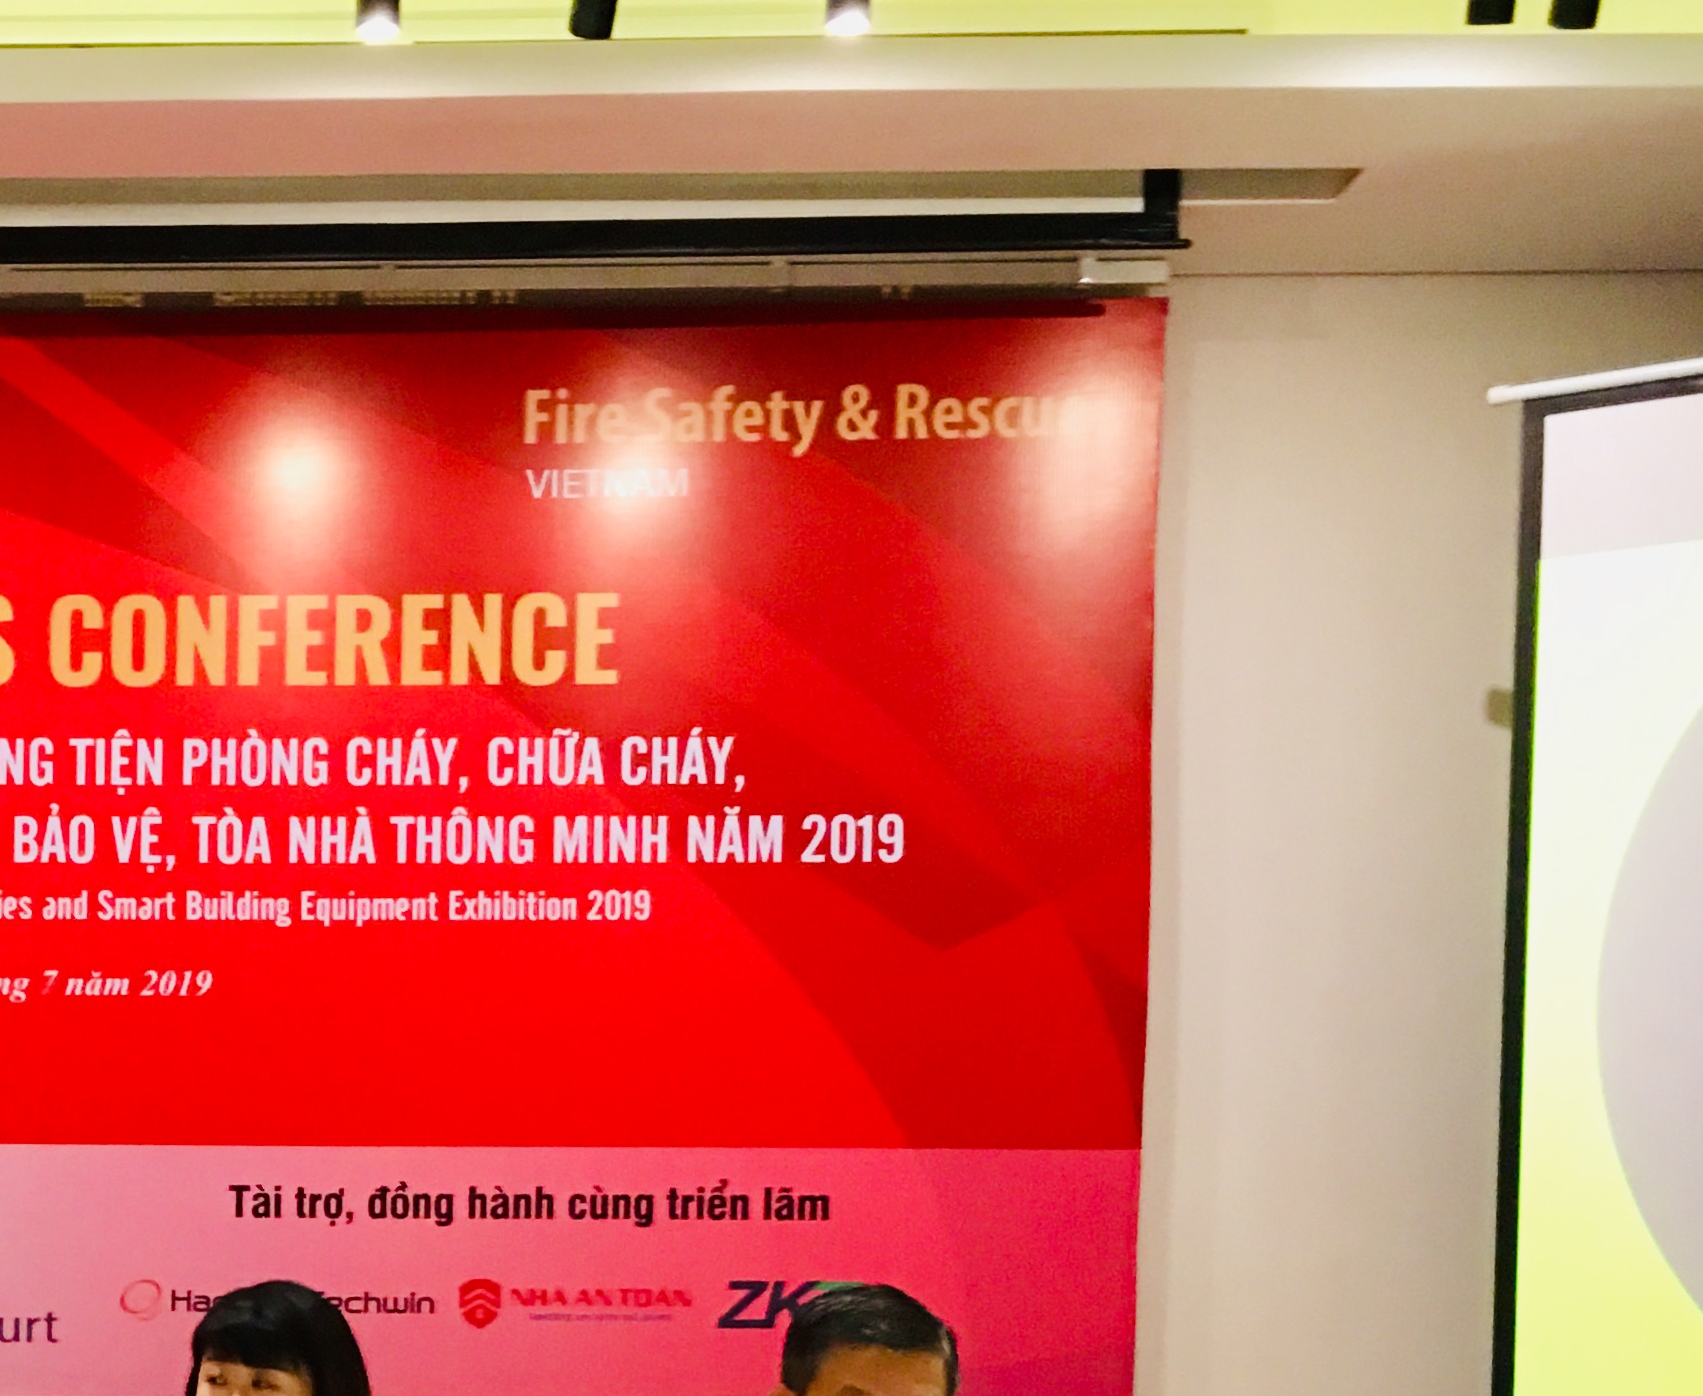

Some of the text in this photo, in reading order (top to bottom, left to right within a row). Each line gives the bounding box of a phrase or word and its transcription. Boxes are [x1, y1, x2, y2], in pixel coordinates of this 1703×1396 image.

[522, 388, 627, 444] Fire
[640, 384, 824, 459] Safety
[836, 383, 879, 441] &
[525, 467, 690, 499] VIETNAM
[48, 591, 620, 688] CONFERENCE
[68, 727, 164, 796] TIỆN
[182, 727, 329, 787] PHÒNG
[345, 727, 470, 794] CHÁY,
[487, 728, 605, 786] CHỮA
[620, 726, 746, 794] CHÁY,
[12, 802, 95, 864] BẢO
[111, 806, 176, 873] VỆ,
[192, 806, 272, 865] TÒA
[288, 806, 376, 865] NHÀ
[390, 805, 536, 865] THÔNG
[552, 814, 669, 865] MINH
[686, 805, 784, 865] NĂM
[800, 813, 906, 865] 2019
[41, 890, 89, 920] and
[97, 889, 175, 921] Smart
[185, 890, 292, 928] Building
[300, 890, 439, 927] Equipment
[448, 889, 578, 921] Exhibition
[586, 889, 652, 922] 2019
[40, 969, 59, 996] 7
[63, 970, 130, 997] năm
[139, 969, 214, 997] 2019
[227, 1178, 831, 1228] Tài trợ, đồng hành cùng triển lãm
[320, 1291, 436, 1315] echwin
